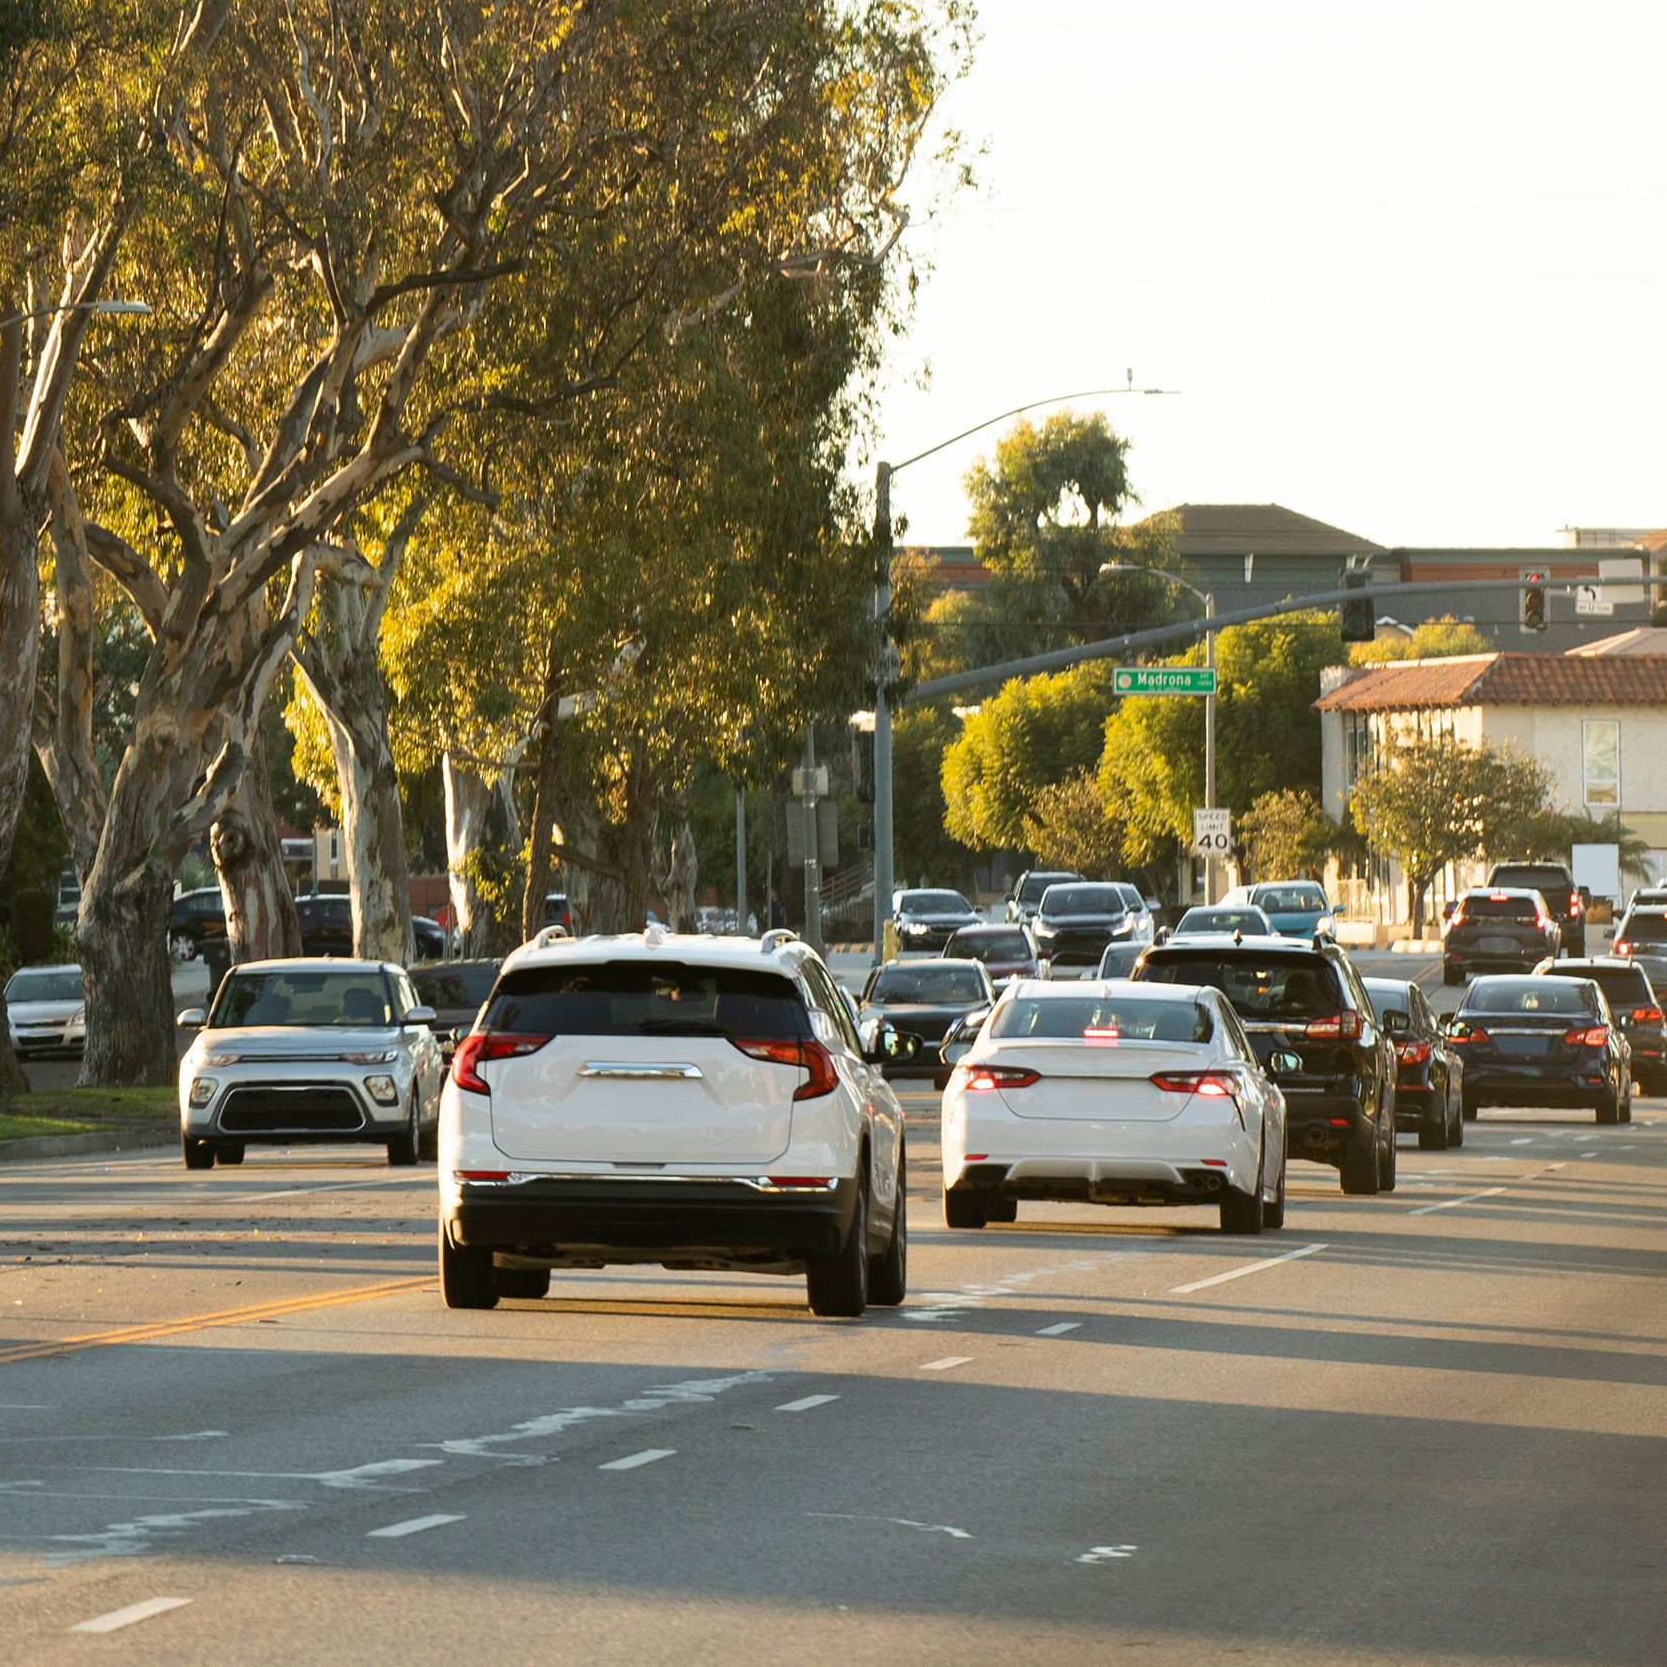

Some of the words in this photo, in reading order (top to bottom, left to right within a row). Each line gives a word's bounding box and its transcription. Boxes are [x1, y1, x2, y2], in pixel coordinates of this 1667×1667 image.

[1137, 672, 1191, 686] Madrona
[1198, 813, 1227, 821] SPEED
[1201, 823, 1223, 831] LIMIT
[1198, 834, 1227, 849] 40
